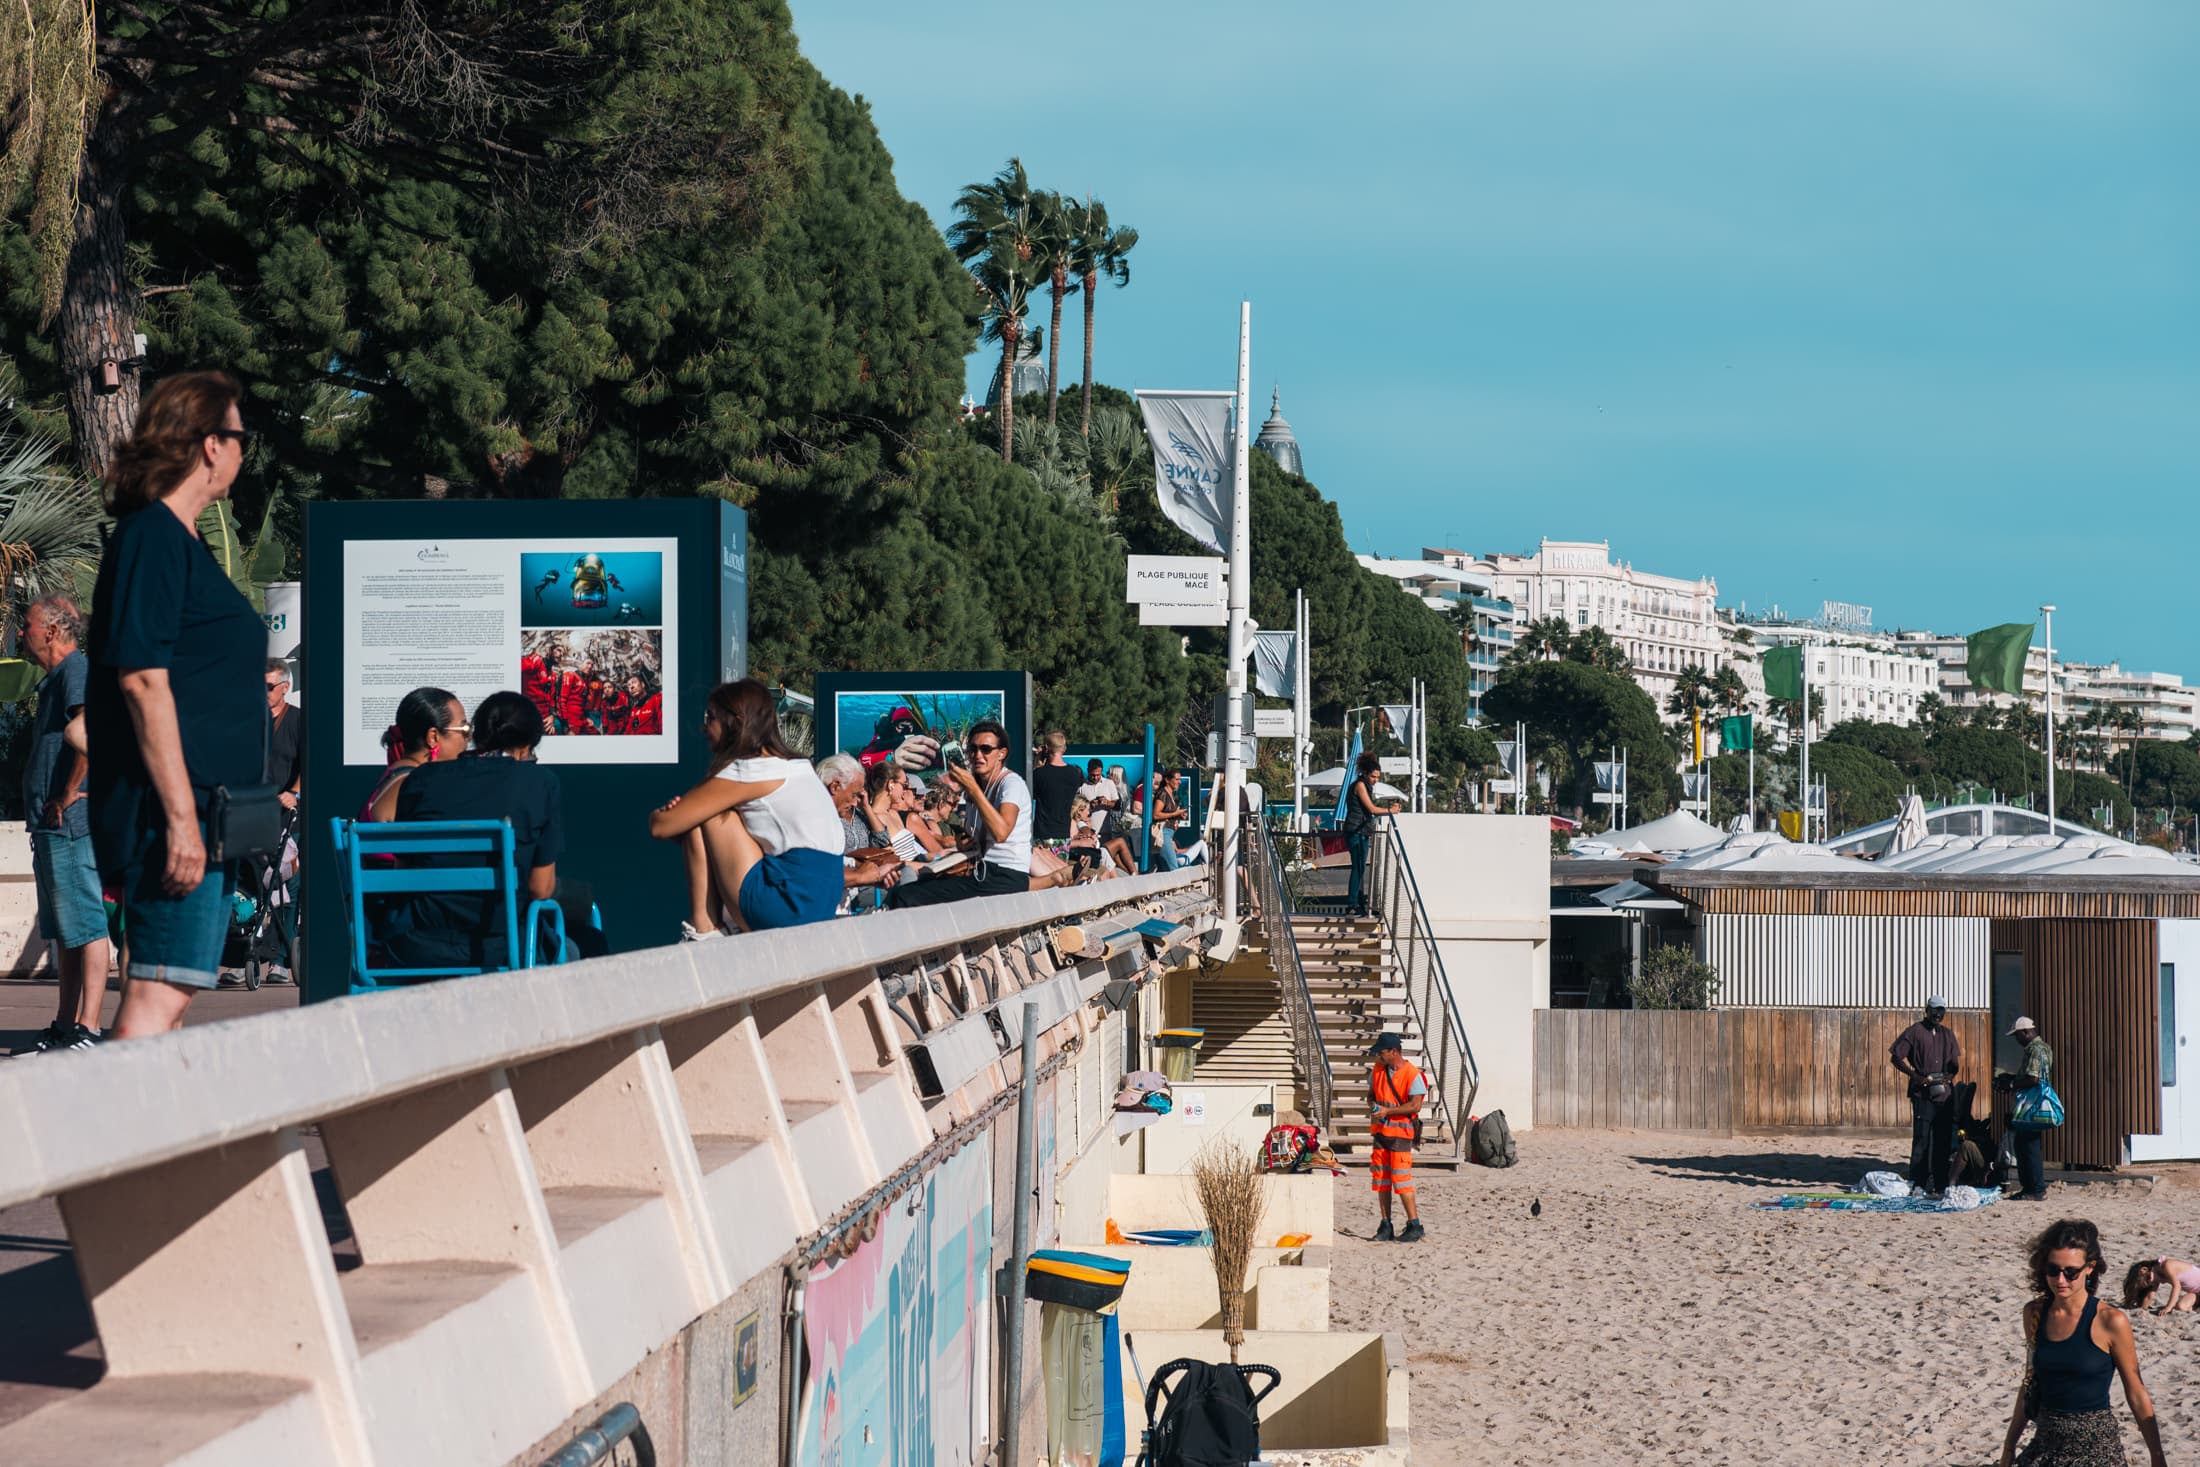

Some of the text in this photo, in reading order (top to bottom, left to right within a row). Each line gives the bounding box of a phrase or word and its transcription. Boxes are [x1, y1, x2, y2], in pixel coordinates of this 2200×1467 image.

[1137, 571, 1209, 580] PLAGE PUBLIQUE
[1824, 600, 1872, 626] MARTINEZ
